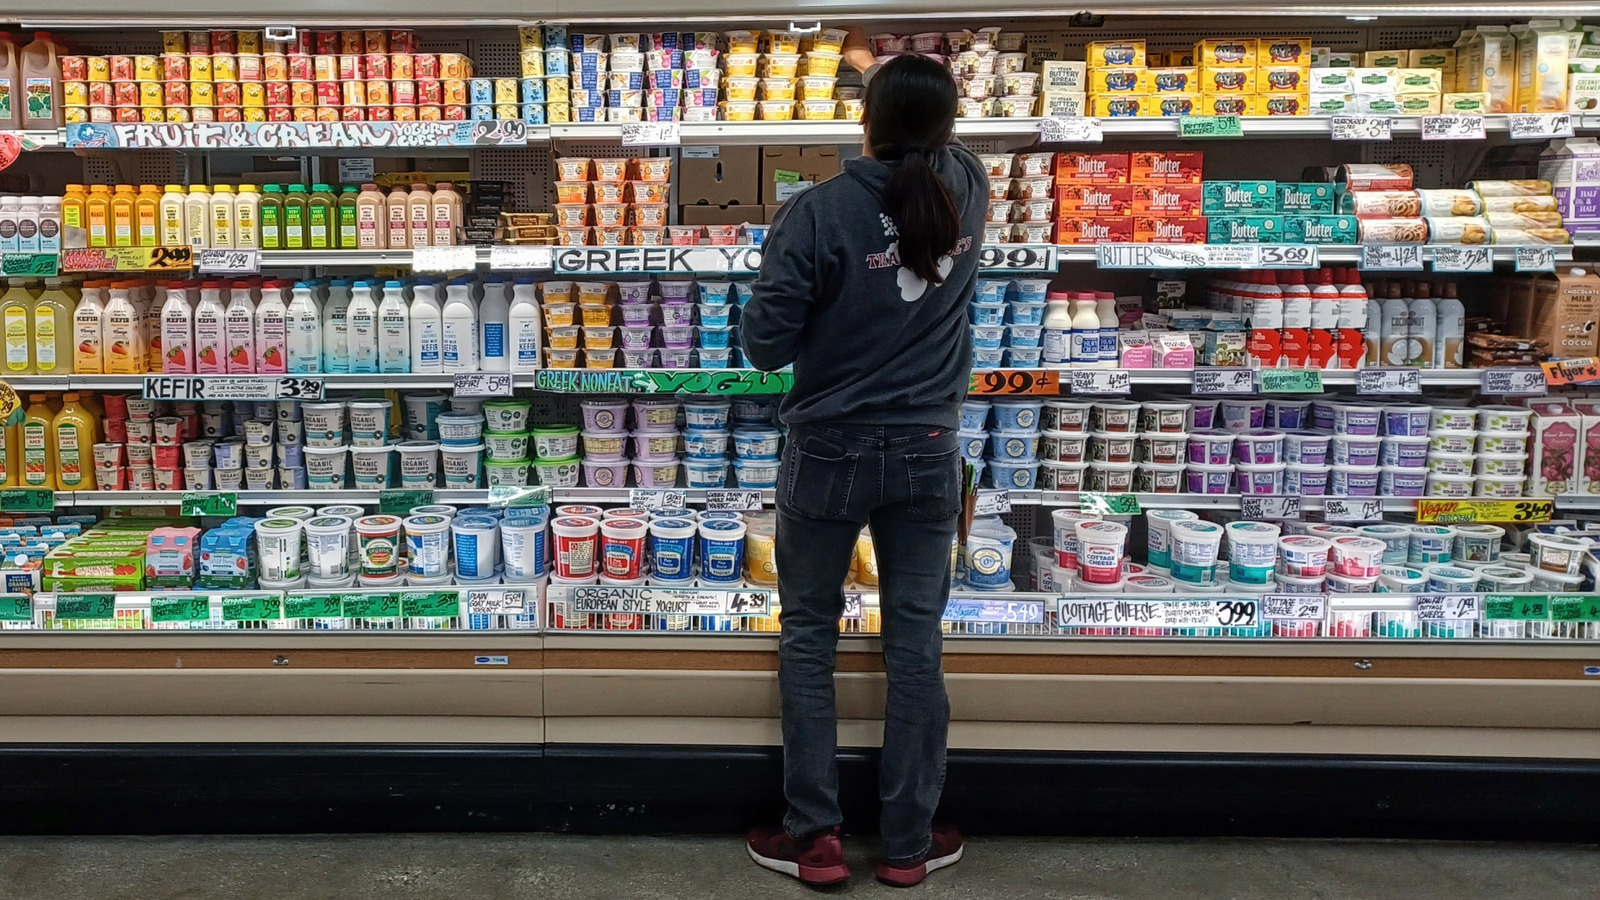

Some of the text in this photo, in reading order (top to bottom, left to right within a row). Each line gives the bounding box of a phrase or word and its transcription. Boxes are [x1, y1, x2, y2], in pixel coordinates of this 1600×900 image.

[229, 123, 250, 147] &
[256, 122, 393, 147] CREAM
[391, 122, 455, 136] YOGURT
[396, 134, 437, 146] CUPS
[1079, 156, 1106, 173] Butter
[1154, 156, 1181, 173] Butter
[1083, 189, 1111, 205] Butter
[1152, 189, 1180, 205] Butter
[1225, 187, 1252, 202] Butter
[1284, 189, 1311, 205] Butter
[1580, 190, 1598, 198] HALF
[1082, 222, 1110, 238] Butter
[1156, 221, 1184, 238] Butter
[1232, 223, 1259, 238] Butter
[1306, 222, 1333, 238] Butter
[65, 249, 105, 259] MANGO
[558, 250, 694, 271] GREEK
[866, 253, 900, 270] TRA
[1102, 246, 1205, 266] BUTTER QUARTERS
[1550, 363, 1584, 380] Flyer
[146, 378, 205, 399] KEFIR
[537, 371, 578, 391] GREEK
[581, 372, 632, 392] NONFAT
[649, 372, 785, 393] YOGU
[1421, 502, 1458, 519] Vegan
[576, 589, 652, 600] ORGANIC
[1265, 598, 1295, 607] COTTAGE
[576, 599, 691, 612] EUROPEAN STYLE YOGURT
[1062, 602, 1114, 624] COTTAGE
